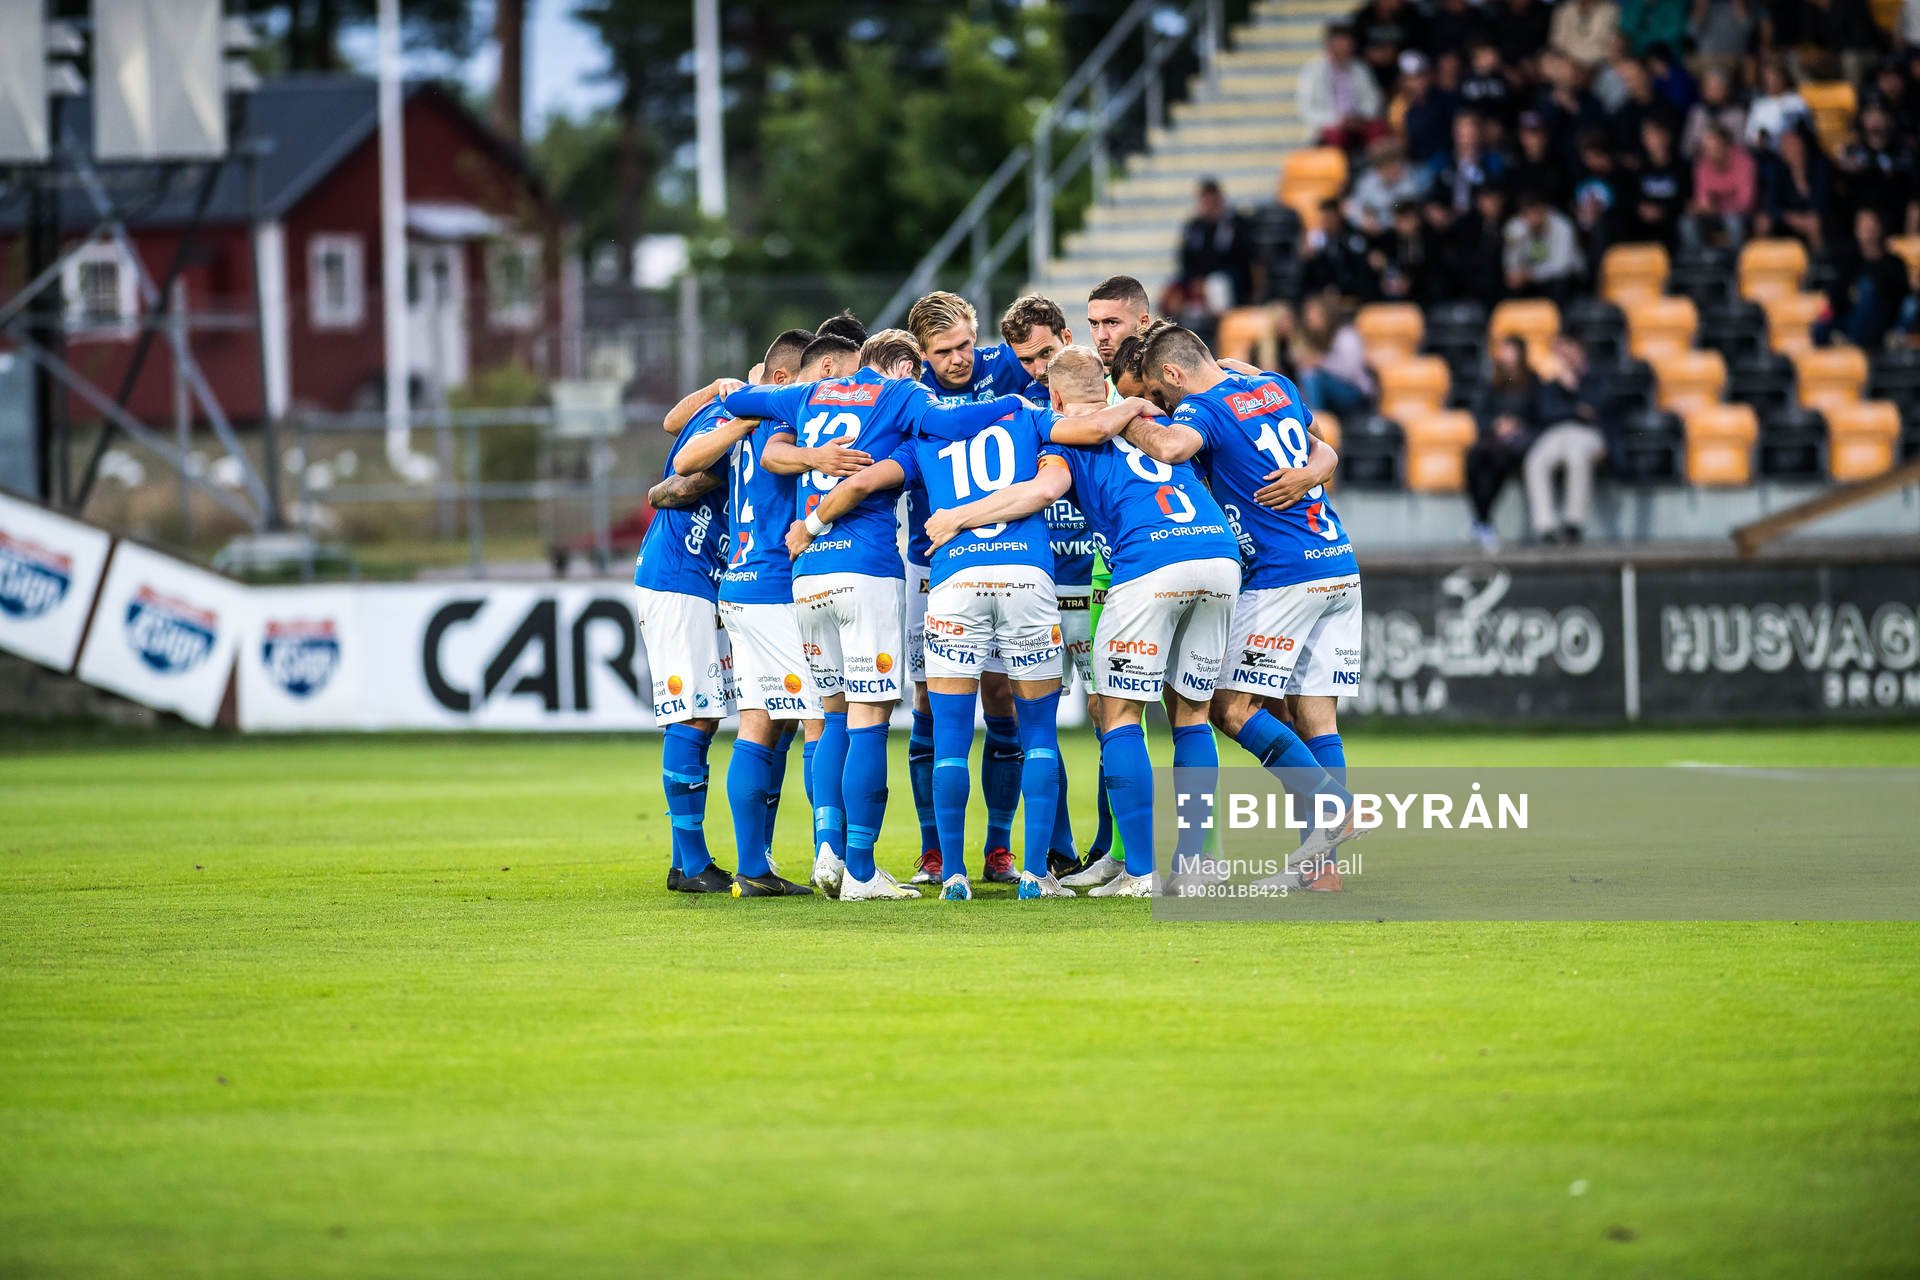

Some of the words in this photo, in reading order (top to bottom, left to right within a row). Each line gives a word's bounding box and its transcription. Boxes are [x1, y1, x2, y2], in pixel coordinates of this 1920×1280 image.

[938, 425, 1016, 500] 10
[1112, 435, 1172, 482] 8
[1254, 417, 1323, 499] 18
[685, 504, 713, 555] Gelia
[1150, 524, 1225, 542] RO-GRUPPEN
[1225, 504, 1256, 556] Gelia
[949, 541, 1028, 559] RO-GRUPPEN
[1304, 543, 1353, 560] RO-GRUPPE
[926, 614, 964, 636] renta
[1109, 638, 1158, 656] renta
[1246, 633, 1295, 652] renta
[1661, 602, 1920, 673] HUSVAG
[423, 598, 640, 713] CAR
[844, 678, 897, 693] INSECTA
[1182, 671, 1218, 691] INSEC
[1232, 668, 1288, 690] INSECT
[1332, 670, 1360, 685] INSE
[654, 698, 686, 717] ECTA
